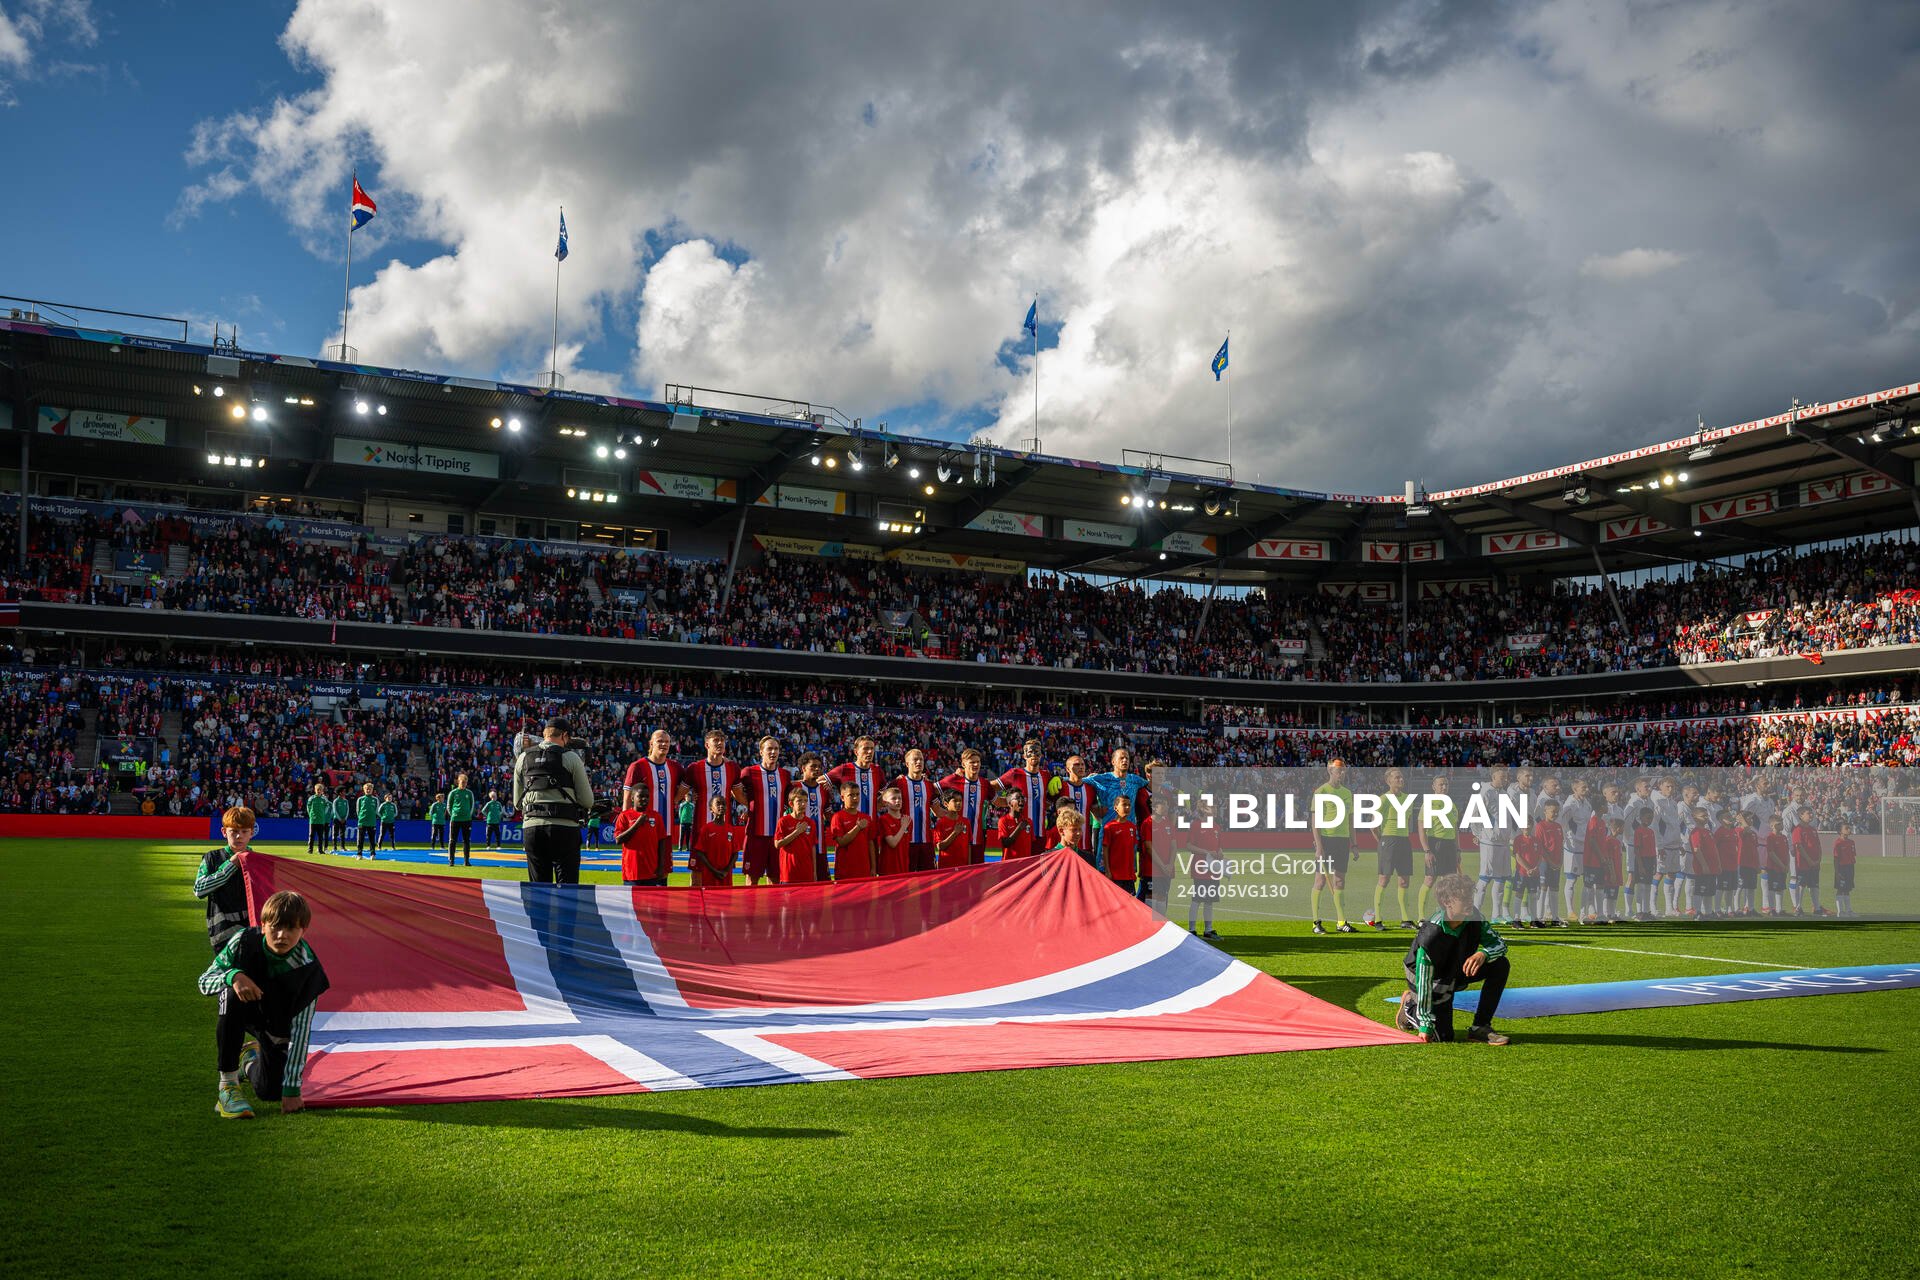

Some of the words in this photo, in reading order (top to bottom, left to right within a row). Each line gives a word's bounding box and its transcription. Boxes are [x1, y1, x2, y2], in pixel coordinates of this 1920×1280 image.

[1877, 386, 1909, 401] VG
[1838, 395, 1868, 411] VG
[1799, 404, 1829, 420] VG
[1765, 413, 1792, 427] VG
[1731, 421, 1757, 435] VG
[1700, 429, 1723, 443] VG
[1666, 437, 1691, 450] VG
[1637, 444, 1660, 457] VG
[386, 451, 423, 466] Norsk
[425, 454, 471, 473] Tipping
[1609, 452, 1631, 464] VG
[1554, 465, 1575, 476] VG
[1580, 459, 1602, 471] VG
[1503, 477, 1523, 488] VG
[1528, 471, 1549, 482] VG
[1452, 487, 1473, 497] VG
[1479, 483, 1497, 493] VG
[1810, 473, 1888, 501] VG
[785, 496, 803, 504] Norsk
[804, 497, 828, 507] Tipping
[1333, 494, 1355, 502] VG
[31, 504, 56, 513] Norsk
[1702, 495, 1769, 523] VG
[311, 527, 332, 535] Norsk
[1609, 517, 1667, 539] VG
[1103, 530, 1123, 541] Tipping
[776, 541, 793, 549] Norsk
[794, 542, 814, 552] Tipping
[1491, 533, 1557, 552] VG
[1258, 542, 1321, 558] VG
[1376, 542, 1434, 560] VG
[1324, 584, 1387, 599] VG
[315, 685, 335, 693] Norsk
[1647, 973, 1902, 996] PEACE
